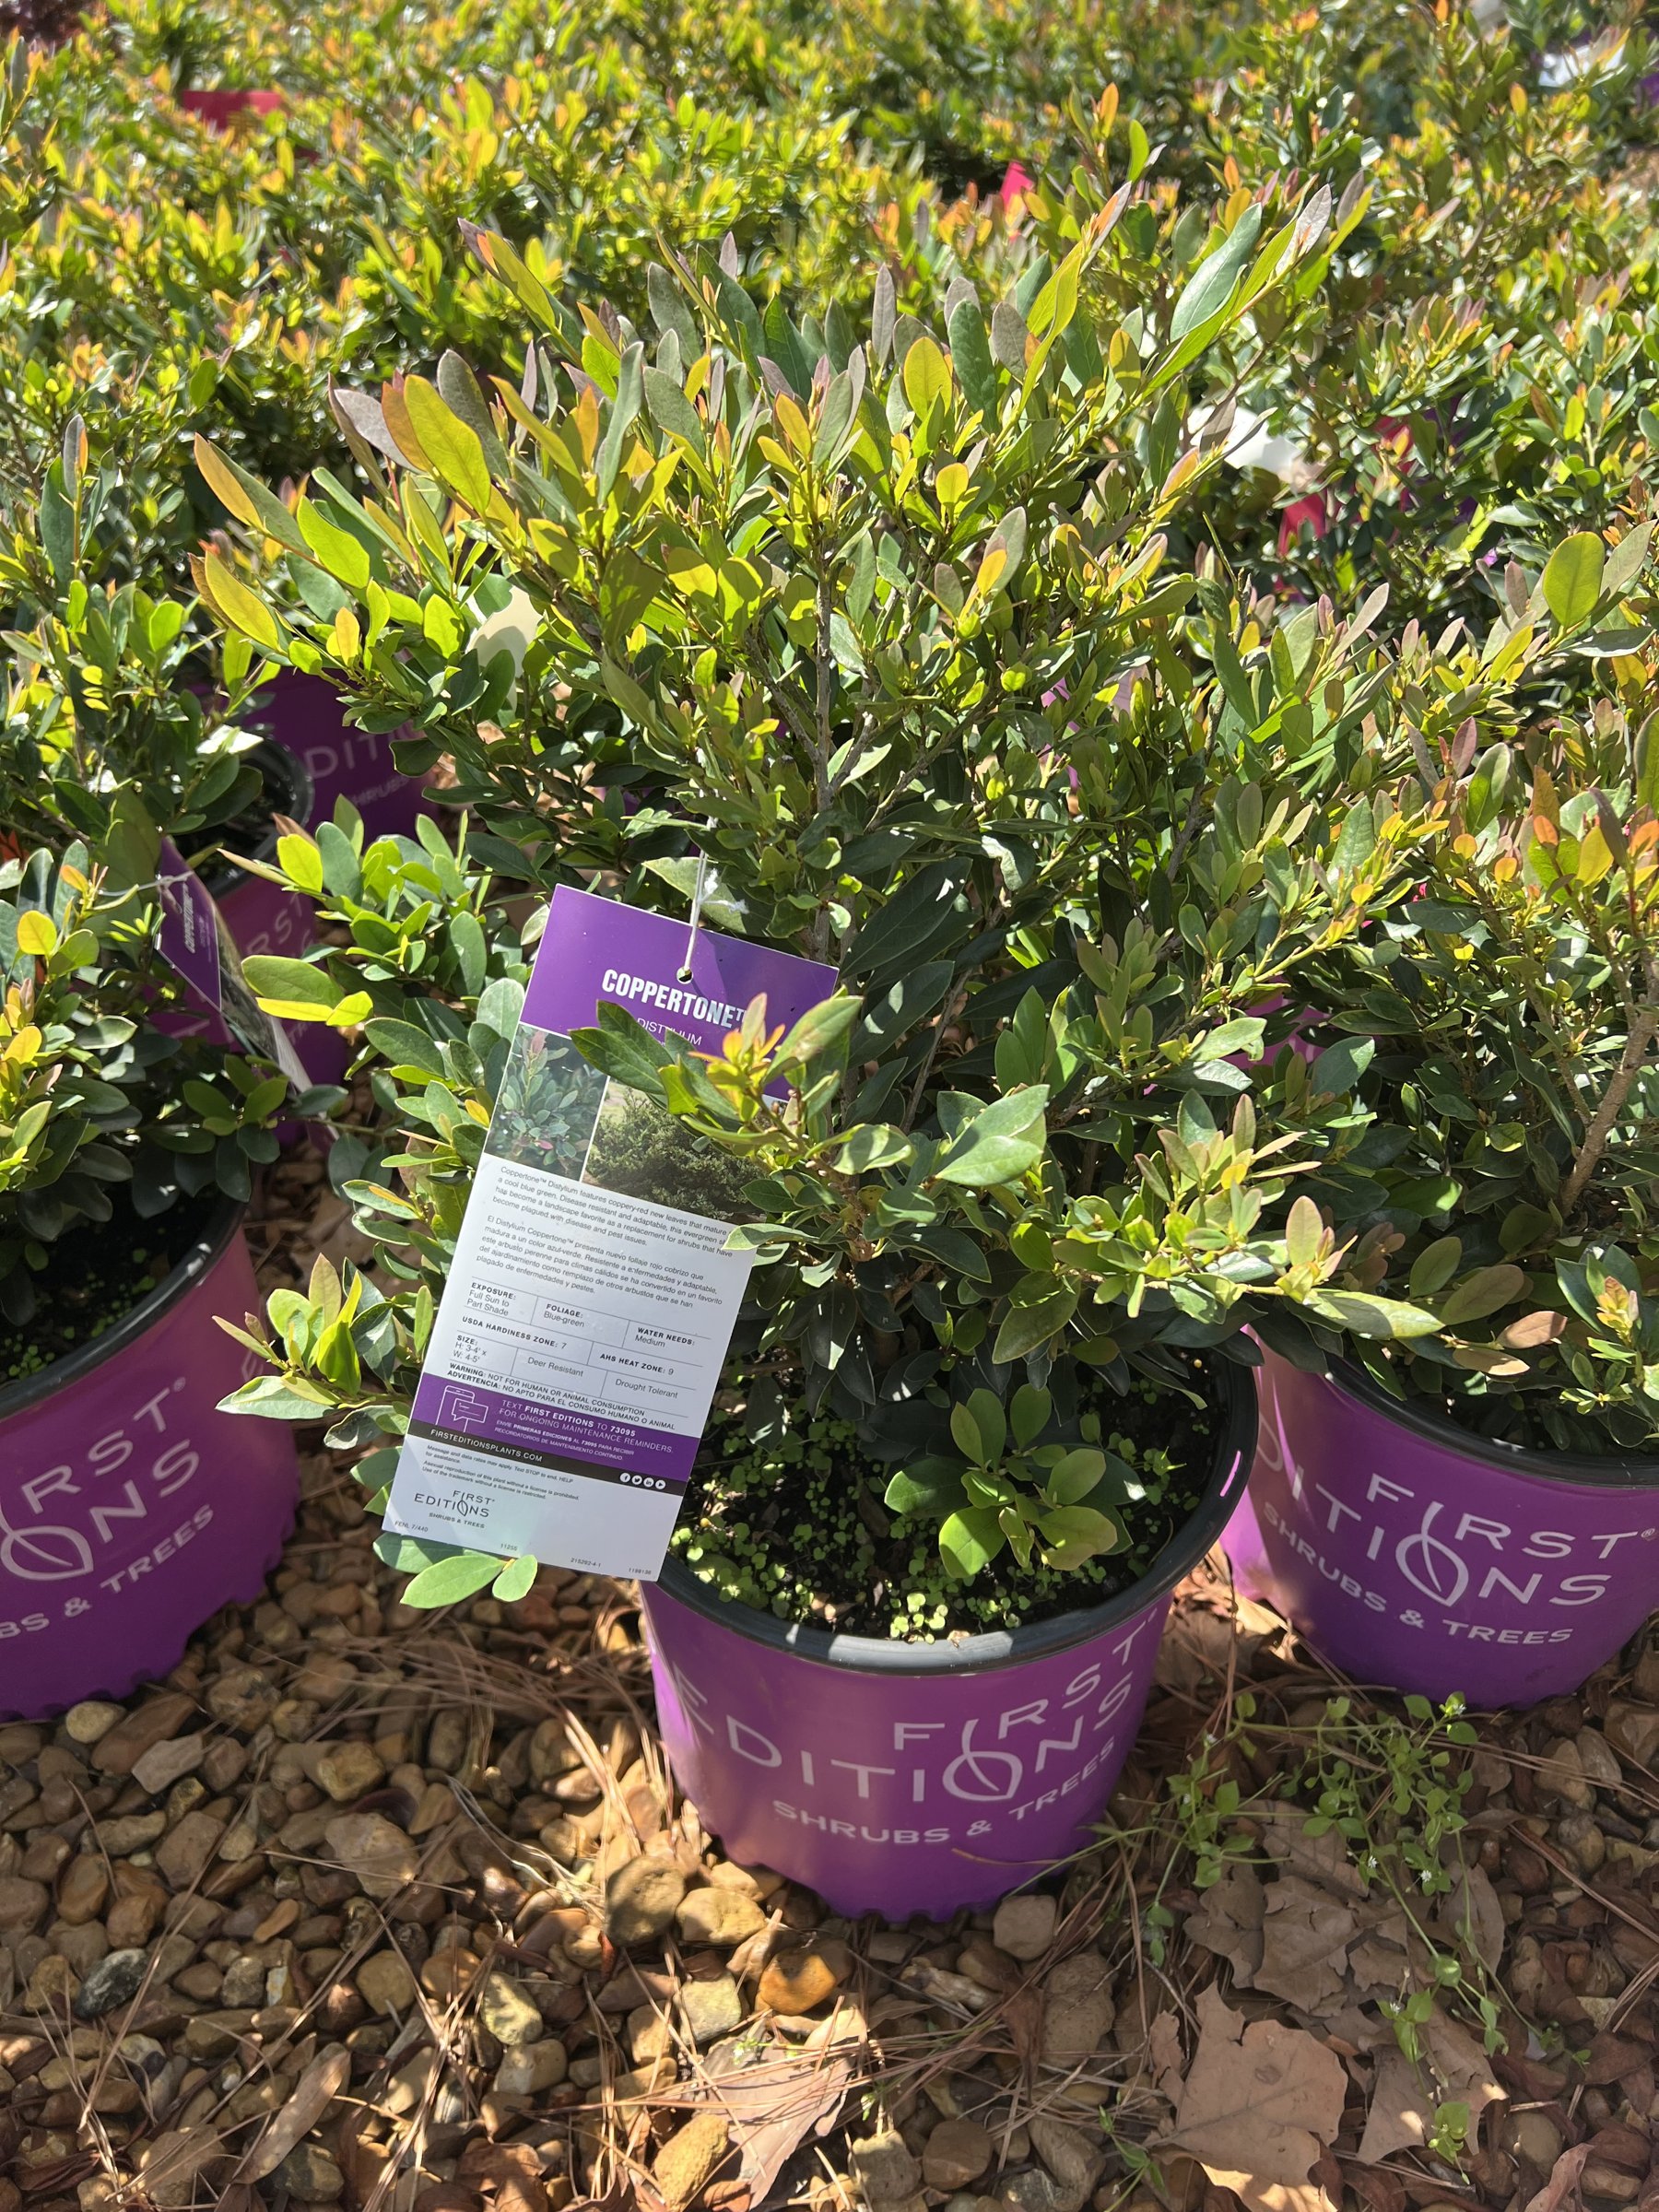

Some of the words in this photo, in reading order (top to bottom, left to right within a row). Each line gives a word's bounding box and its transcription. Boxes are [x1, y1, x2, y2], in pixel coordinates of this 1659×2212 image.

[492, 1194, 520, 1209] become
[520, 1205, 548, 1218] plagued
[549, 1214, 564, 1222] with
[563, 1218, 592, 1230] disease
[592, 1226, 607, 1234] and
[606, 1230, 623, 1239] pest
[495, 1185, 508, 1195] has
[509, 1190, 536, 1203] become
[544, 1200, 579, 1216] landscape
[580, 1210, 605, 1223] favorite
[623, 1224, 665, 1240] replacement
[665, 1234, 676, 1242] for
[677, 1238, 700, 1249] shrubs
[701, 1244, 715, 1253] that
[715, 1246, 733, 1257] have
[503, 1179, 519, 1187] cool
[520, 1182, 535, 1193] blue
[559, 1194, 586, 1207] Disease
[587, 1204, 617, 1216] resistant
[618, 1212, 632, 1220] and
[669, 1225, 682, 1234] this
[683, 1230, 717, 1243] evergreen
[547, 1180, 578, 1194] Distylium
[579, 1189, 606, 1203] features
[607, 1198, 649, 1215] coppery-red
[649, 1210, 665, 1218] new
[665, 1213, 688, 1225] leaves
[688, 1220, 702, 1229] that
[702, 1225, 726, 1235] mature
[484, 1226, 510, 1238] madura
[527, 1239, 546, 1248] color
[583, 1253, 619, 1268] Resistente
[487, 1214, 494, 1222] El
[495, 1217, 525, 1231] Distylium
[573, 1241, 604, 1254] presenta
[605, 1250, 626, 1260] nuevo
[628, 1255, 648, 1266] follaje
[649, 1262, 663, 1270] rojo
[664, 1266, 689, 1277] cobrizo
[689, 1272, 703, 1280] que
[478, 1244, 490, 1253] del
[490, 1249, 540, 1267] ajardinamiento
[541, 1264, 560, 1274] como
[562, 1269, 594, 1283] remplazo
[605, 1281, 623, 1290] otros
[624, 1286, 653, 1298] arbustos
[654, 1294, 669, 1302] que
[679, 1299, 693, 1308] han
[481, 1235, 496, 1244] este
[497, 1241, 523, 1252] arbusto
[524, 1248, 552, 1261] perenne
[553, 1256, 570, 1265] para
[571, 1261, 593, 1272] climas
[594, 1268, 618, 1279] cálidos
[629, 1276, 639, 1285] ha
[640, 1280, 676, 1293] convertido
[698, 1293, 723, 1305] favorito
[466, 1297, 482, 1309] Part
[483, 1302, 508, 1316] Shade
[468, 1288, 483, 1300] Full
[484, 1293, 500, 1304] Sun
[500, 1299, 510, 1307] to
[471, 1281, 515, 1300] EXPOSURE:
[543, 1311, 584, 1327] Blue-green
[546, 1303, 582, 1317] FOLIAGE:
[456, 1335, 477, 1346] SIZE:
[462, 1315, 483, 1326] USDA
[485, 1323, 531, 1340] HARDINESS
[533, 1335, 557, 1347] ZONE:
[634, 1334, 665, 1347] Medium
[637, 1327, 664, 1338] WATER
[665, 1334, 695, 1345] NEEDS:
[526, 1356, 546, 1367] Deer
[547, 1361, 583, 1376] Resistant
[599, 1353, 616, 1361] AHS
[618, 1357, 639, 1367] HEAT
[641, 1362, 665, 1372] ZONE:
[488, 1372, 503, 1382] NOT
[504, 1377, 520, 1386] FOR
[521, 1382, 548, 1394] HUMAN
[549, 1388, 561, 1396] OR
[562, 1392, 589, 1404] ANIMAL
[591, 1399, 644, 1416] CONSUMPTION
[615, 1378, 645, 1391] Drought
[648, 1385, 677, 1398] Tolerant
[498, 1407, 517, 1418] FOR
[518, 1413, 559, 1428] ONGOING
[561, 1423, 621, 1442] MAINTENANCE
[502, 1399, 522, 1409] TEXT
[524, 1405, 550, 1417] FIRST
[552, 1412, 594, 1427] EDITIONS
[597, 1422, 607, 1430] TO
[610, 1425, 635, 1436] 73095
[514, 1388, 535, 1397] APTO
[535, 1393, 555, 1402] PARA
[568, 1401, 606, 1414] CONSUMO
[606, 1410, 640, 1422] HUMANO
[648, 1419, 675, 1430] ANIMAL
[430, 1429, 542, 1461] FIRSTEDITIONSPLANTS.COM
[413, 1492, 489, 1517] EDITIONS
[1257, 1412, 1612, 1607] DITIONS
[65, 1597, 91, 1618] &
[100, 1504, 213, 1594] TREES
[1263, 1501, 1387, 1612] SHRUBS
[1399, 1609, 1424, 1629] &
[1442, 1619, 1573, 1644] TREES
[773, 1800, 949, 1844] SHRUBS
[967, 1819, 994, 1837] &
[1008, 1736, 1115, 1821] TREES
